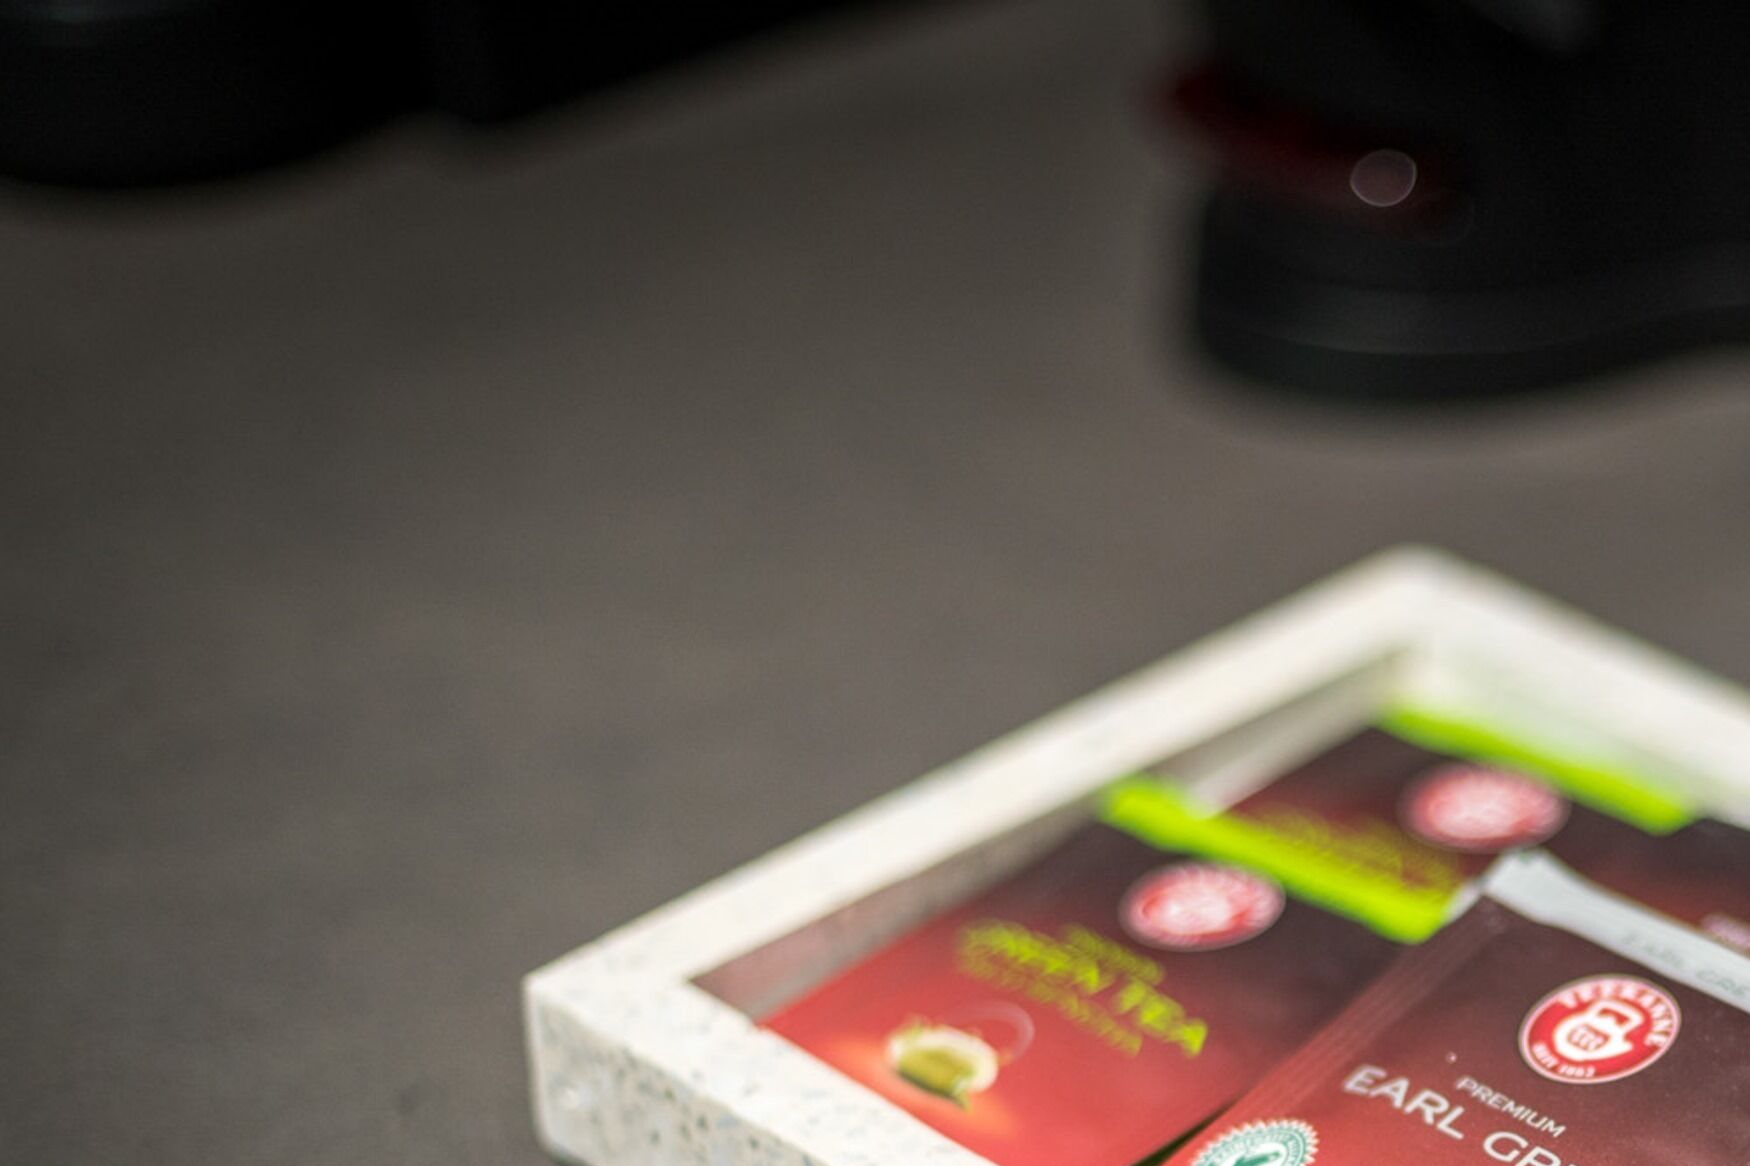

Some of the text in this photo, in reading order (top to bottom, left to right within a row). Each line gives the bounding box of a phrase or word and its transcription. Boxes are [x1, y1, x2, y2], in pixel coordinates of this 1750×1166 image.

[1112, 978, 1208, 1057] TEA
[1555, 979, 1676, 1050] TEEKANNE
[1343, 1063, 1466, 1142] EARL
[1455, 1074, 1567, 1139] PREMIUM
